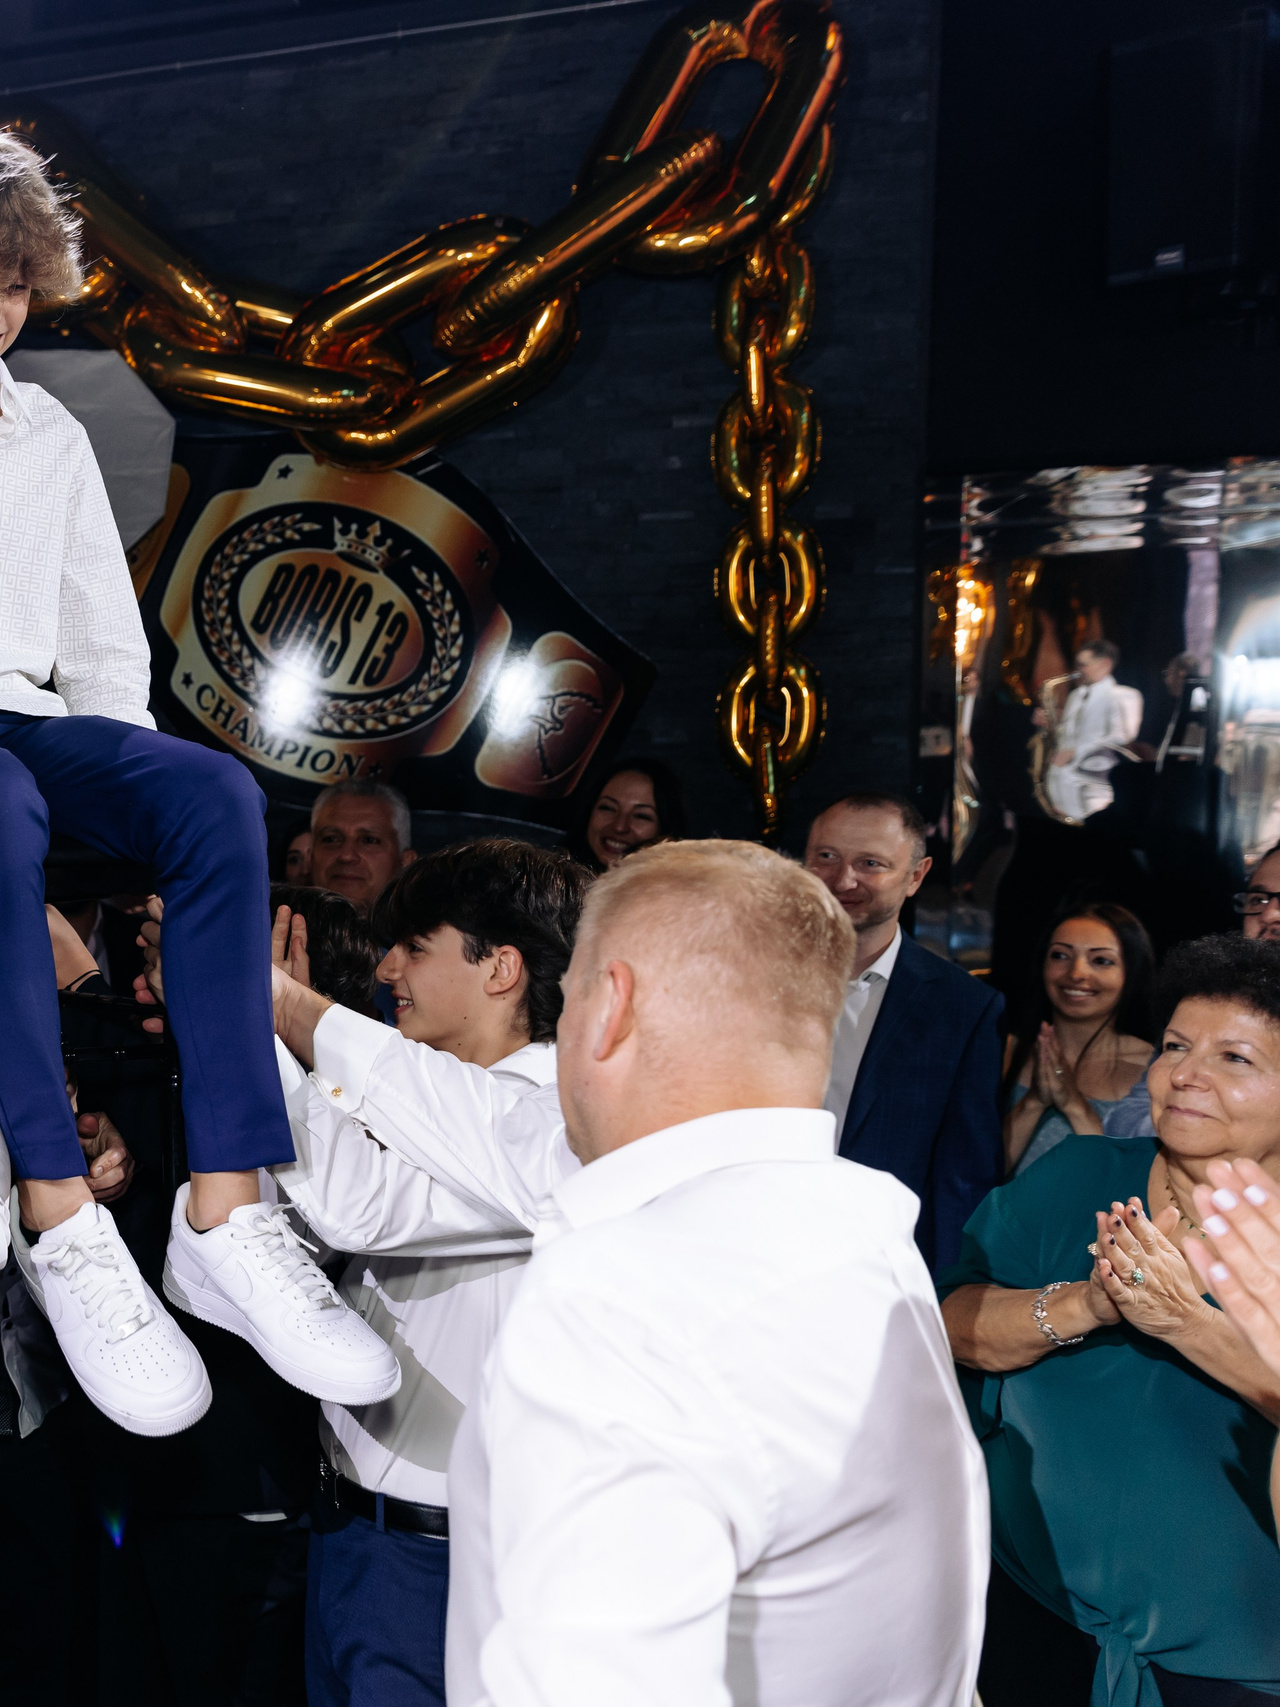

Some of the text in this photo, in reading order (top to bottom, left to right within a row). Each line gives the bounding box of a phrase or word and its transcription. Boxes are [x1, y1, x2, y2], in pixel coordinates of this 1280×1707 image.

[250, 563, 409, 687] BORIS 13
[196, 684, 363, 777] CHAMPION
